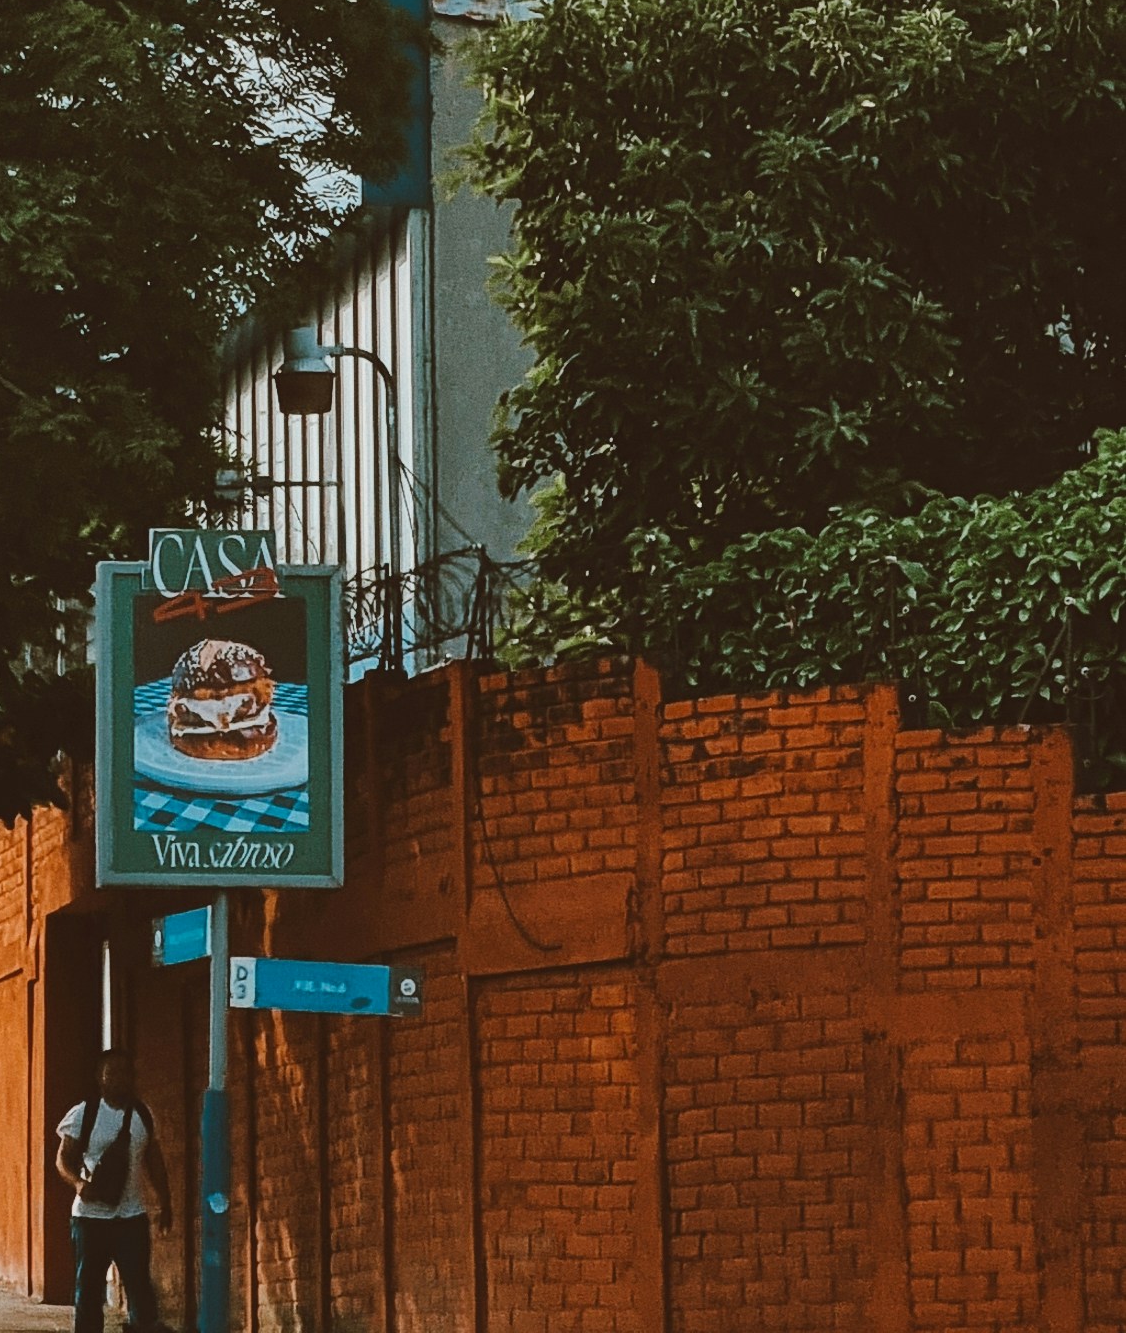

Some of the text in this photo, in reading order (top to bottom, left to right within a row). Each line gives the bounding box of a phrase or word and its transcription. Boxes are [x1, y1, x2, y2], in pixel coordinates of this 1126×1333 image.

[152, 533, 287, 599] CASA
[151, 834, 295, 869] Viva sabroso
